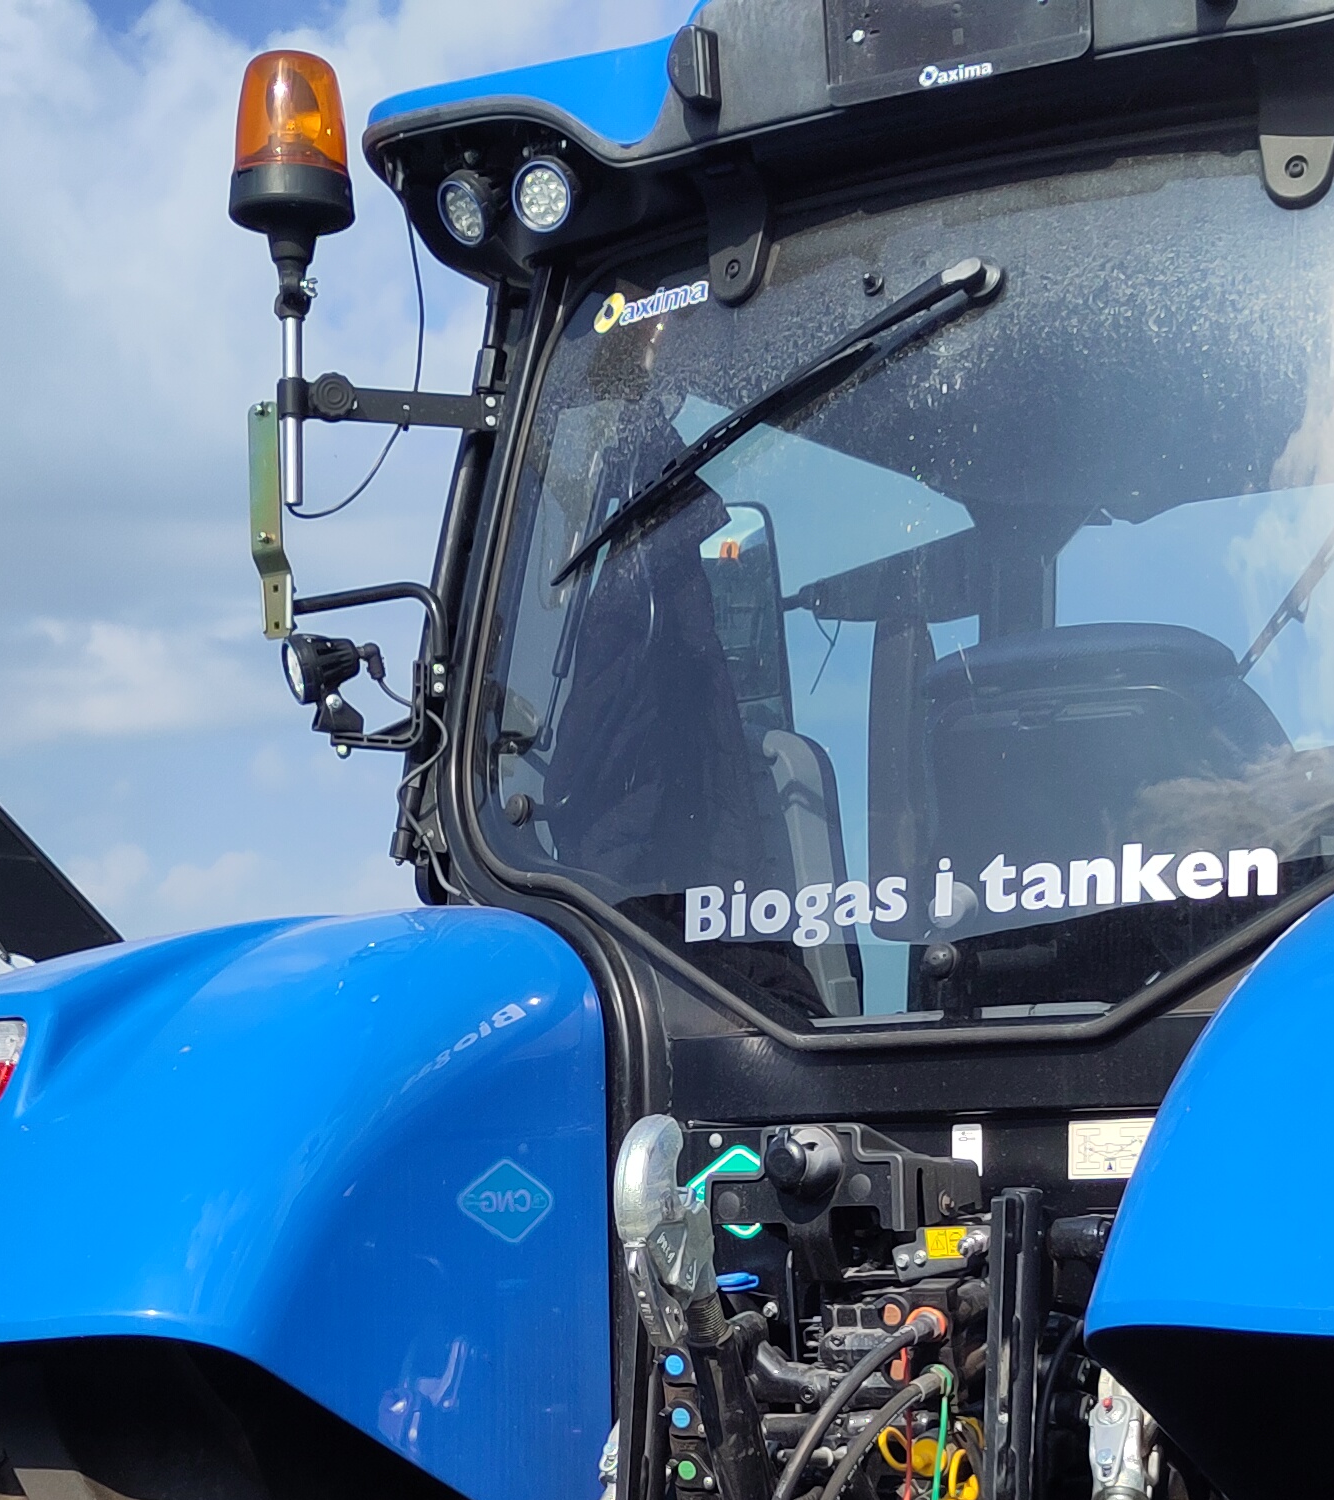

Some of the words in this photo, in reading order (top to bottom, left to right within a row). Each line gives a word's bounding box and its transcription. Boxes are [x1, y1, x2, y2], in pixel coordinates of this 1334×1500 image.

[684, 876, 908, 948] Biogas
[934, 857, 955, 917] i
[979, 842, 1279, 914] tanken
